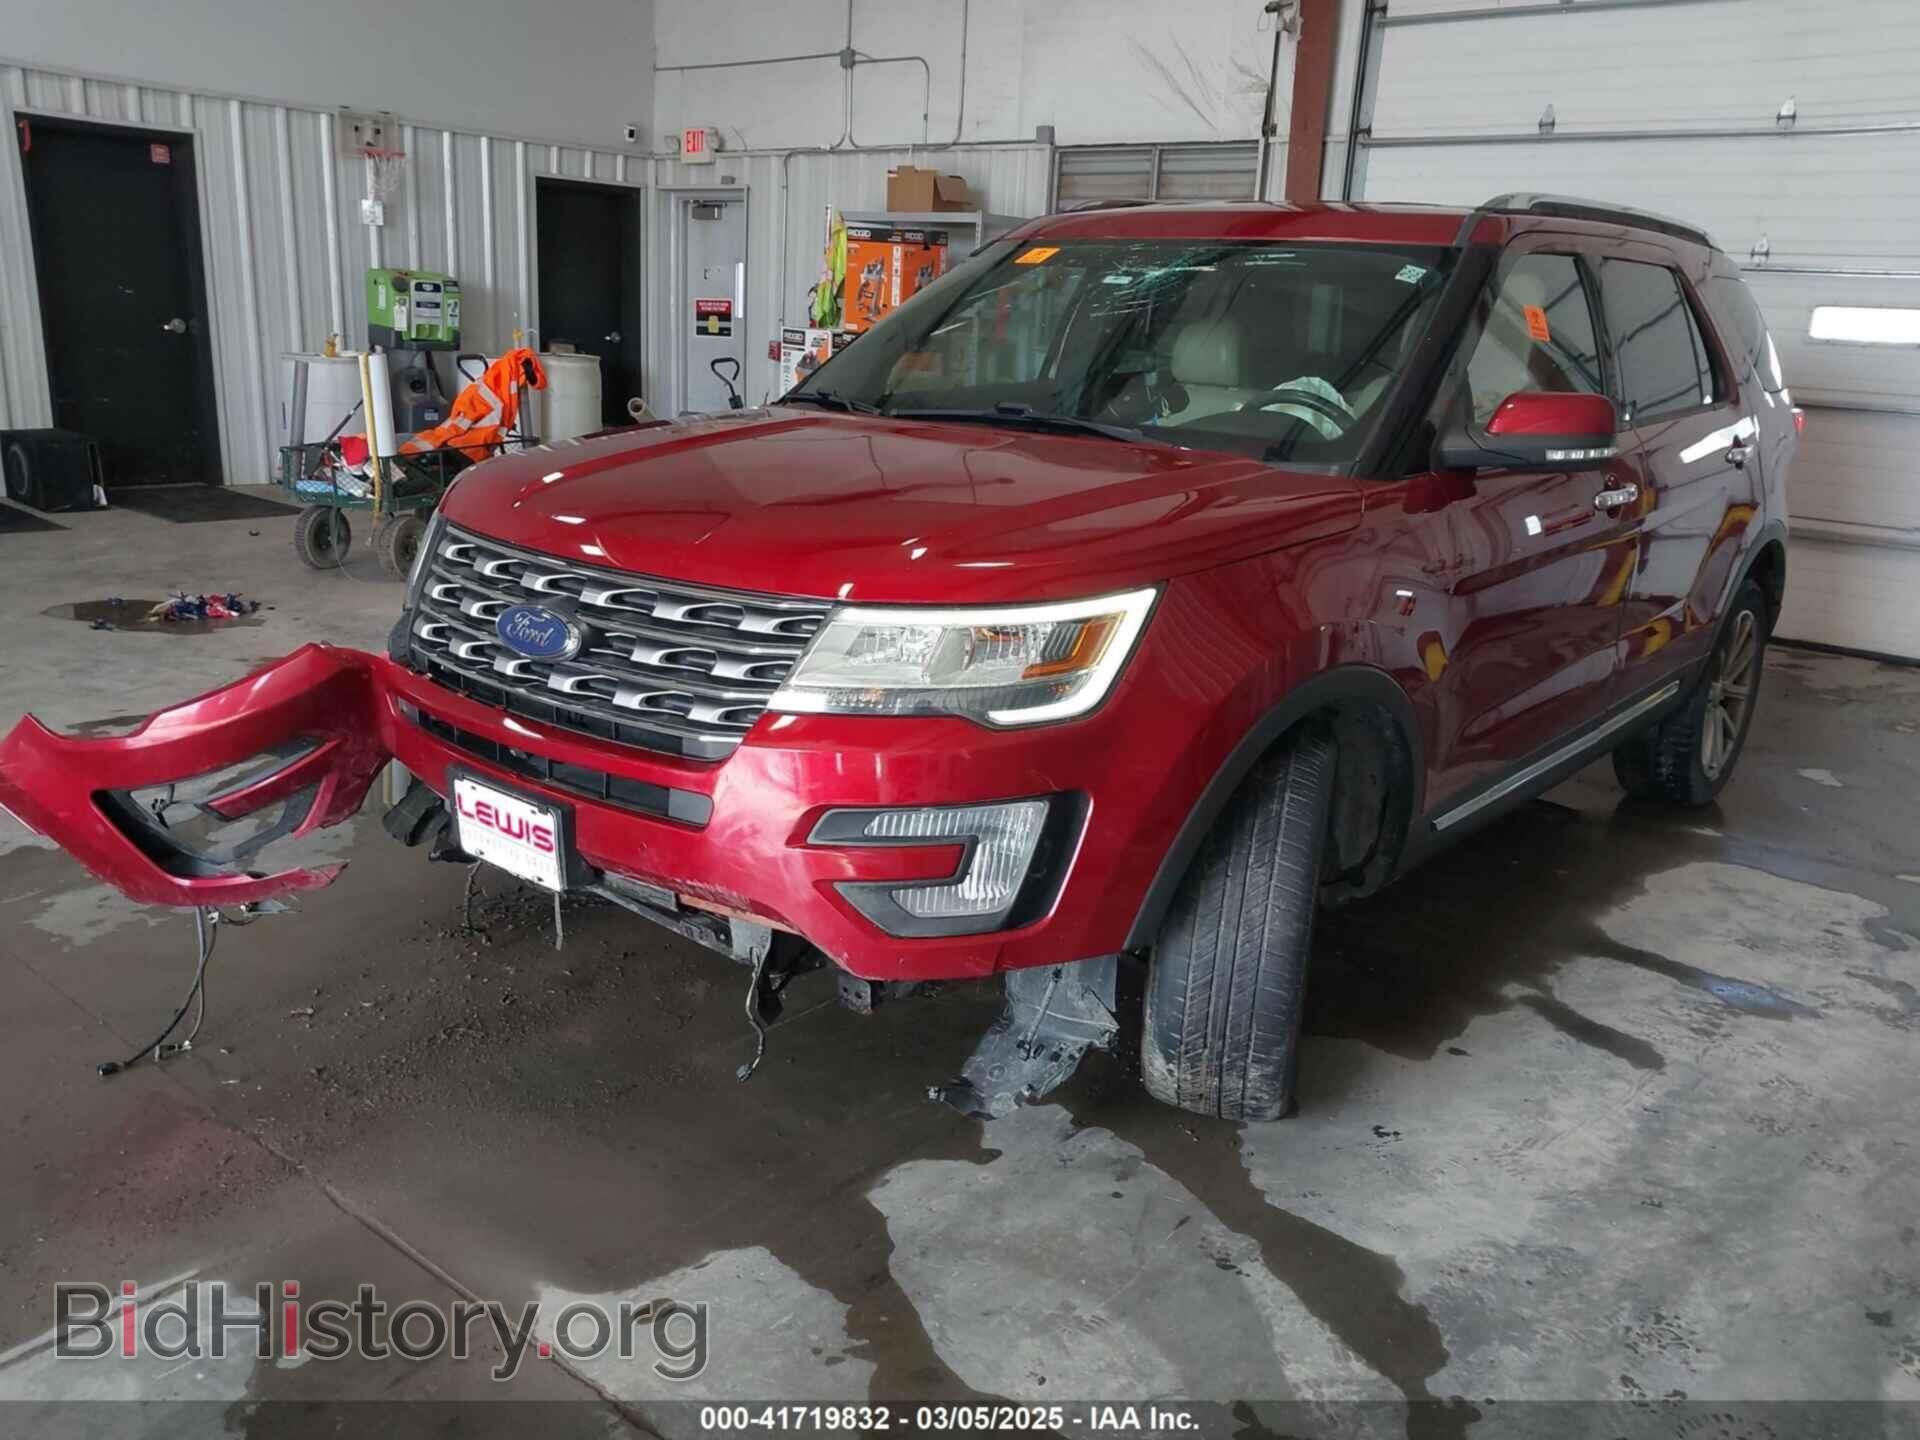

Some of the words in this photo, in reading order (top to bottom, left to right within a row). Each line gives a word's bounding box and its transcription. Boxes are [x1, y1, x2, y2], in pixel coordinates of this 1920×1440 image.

[686, 130, 705, 152] EXIT
[506, 611, 555, 648] Ford
[457, 793, 554, 853] LEWIS
